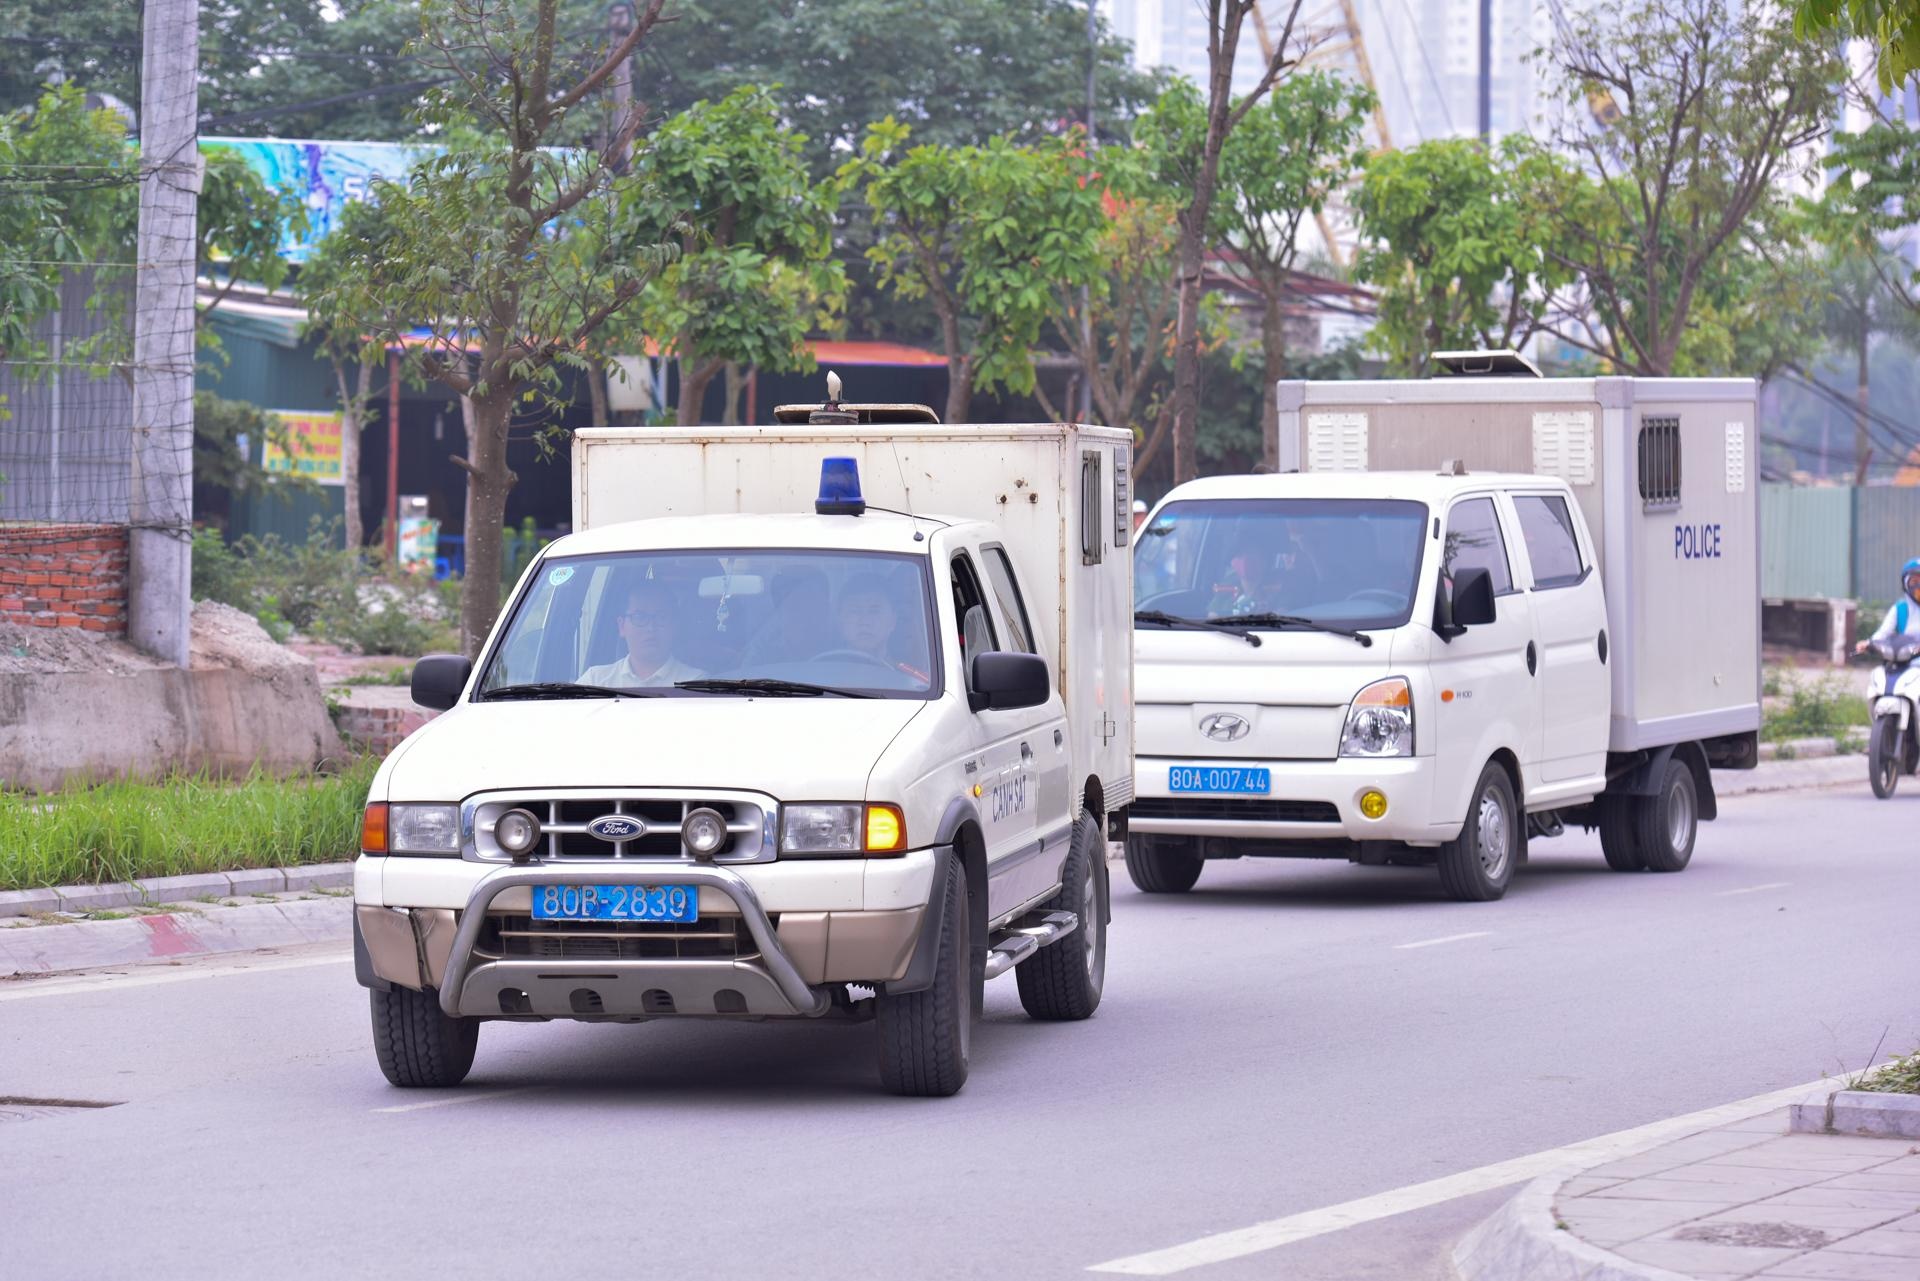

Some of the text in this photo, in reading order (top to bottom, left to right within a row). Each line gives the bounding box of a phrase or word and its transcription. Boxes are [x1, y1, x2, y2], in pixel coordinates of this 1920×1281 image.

[1675, 524, 1721, 559] POLICE
[602, 822, 629, 834] Ford
[543, 885, 687, 918] 80B-2839
